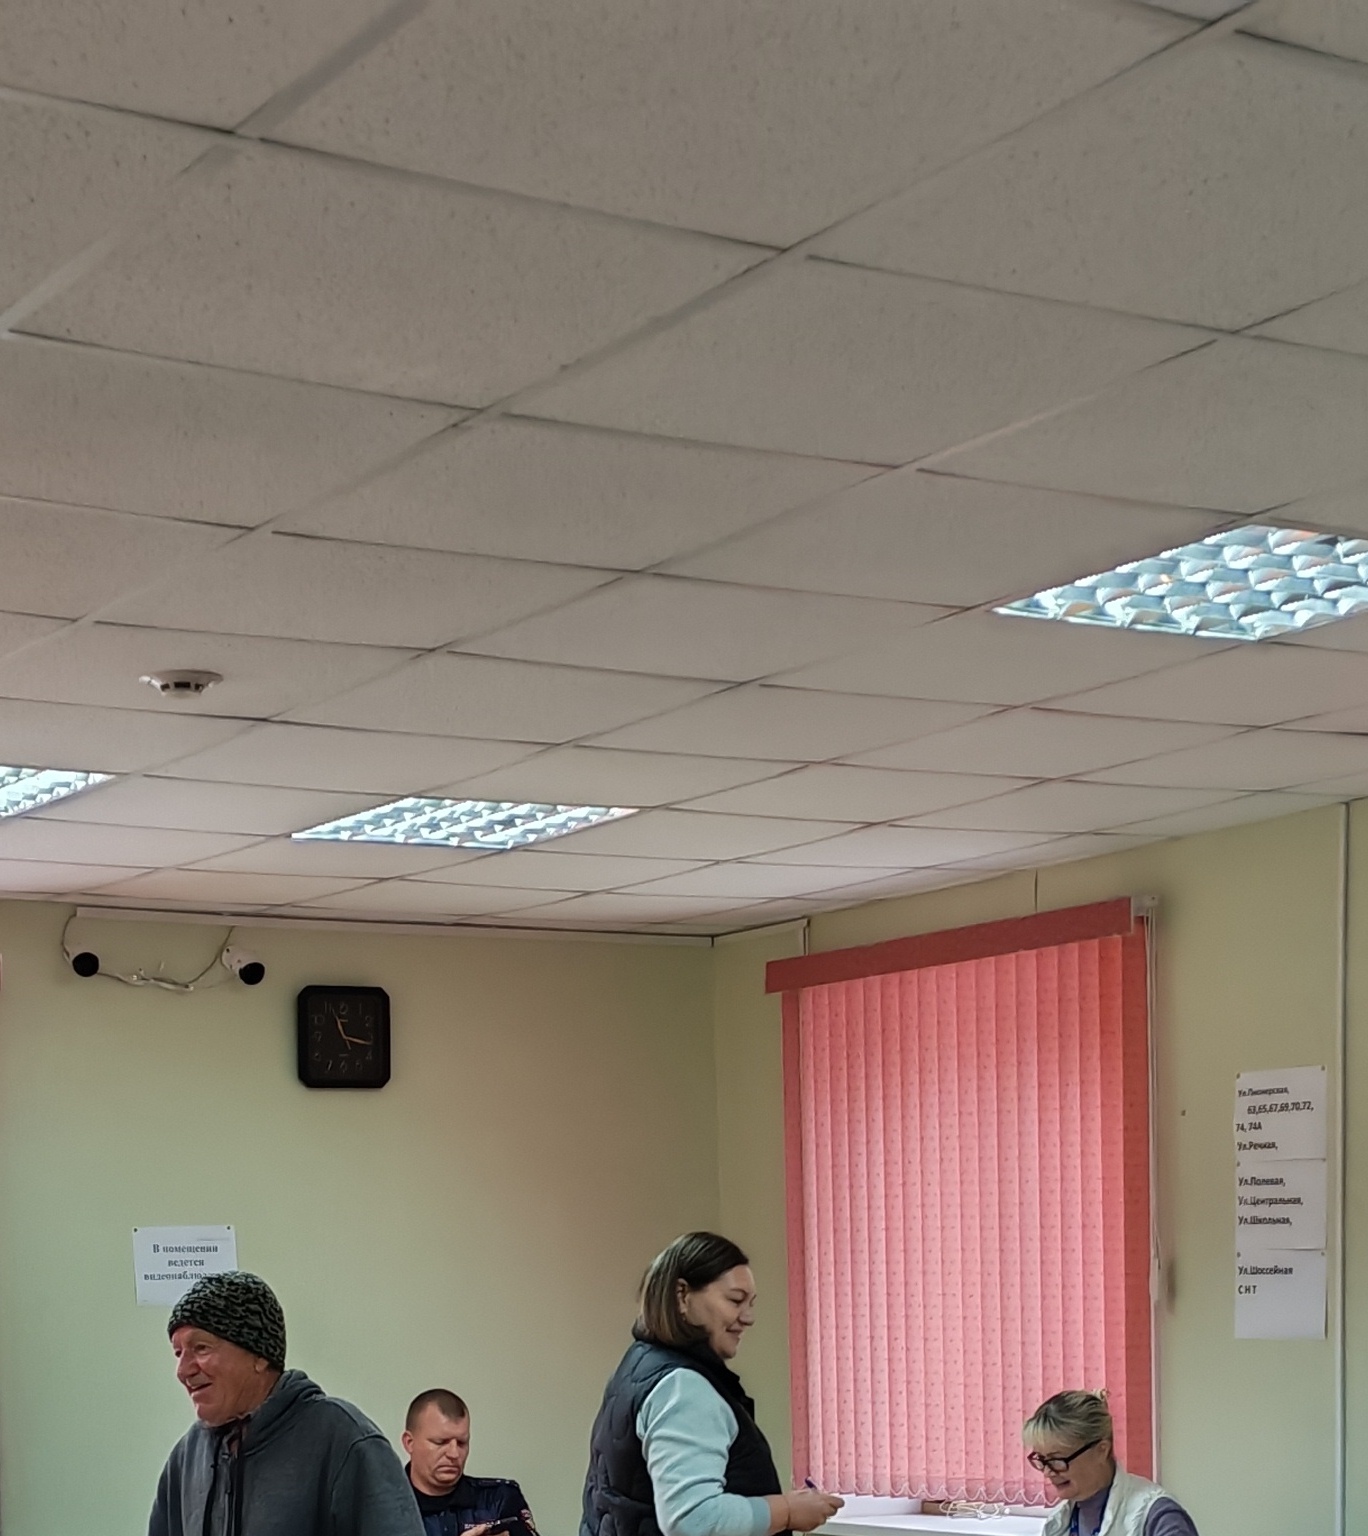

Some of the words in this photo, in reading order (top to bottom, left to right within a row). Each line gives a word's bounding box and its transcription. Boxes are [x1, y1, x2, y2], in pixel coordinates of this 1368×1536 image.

[152, 1243, 160, 1253] В
[162, 1244, 219, 1254] помещении
[167, 1259, 205, 1268] ведется
[143, 1270, 221, 1281] видеонаблю
[1238, 1265, 1294, 1276] Ул.Шоссейная
